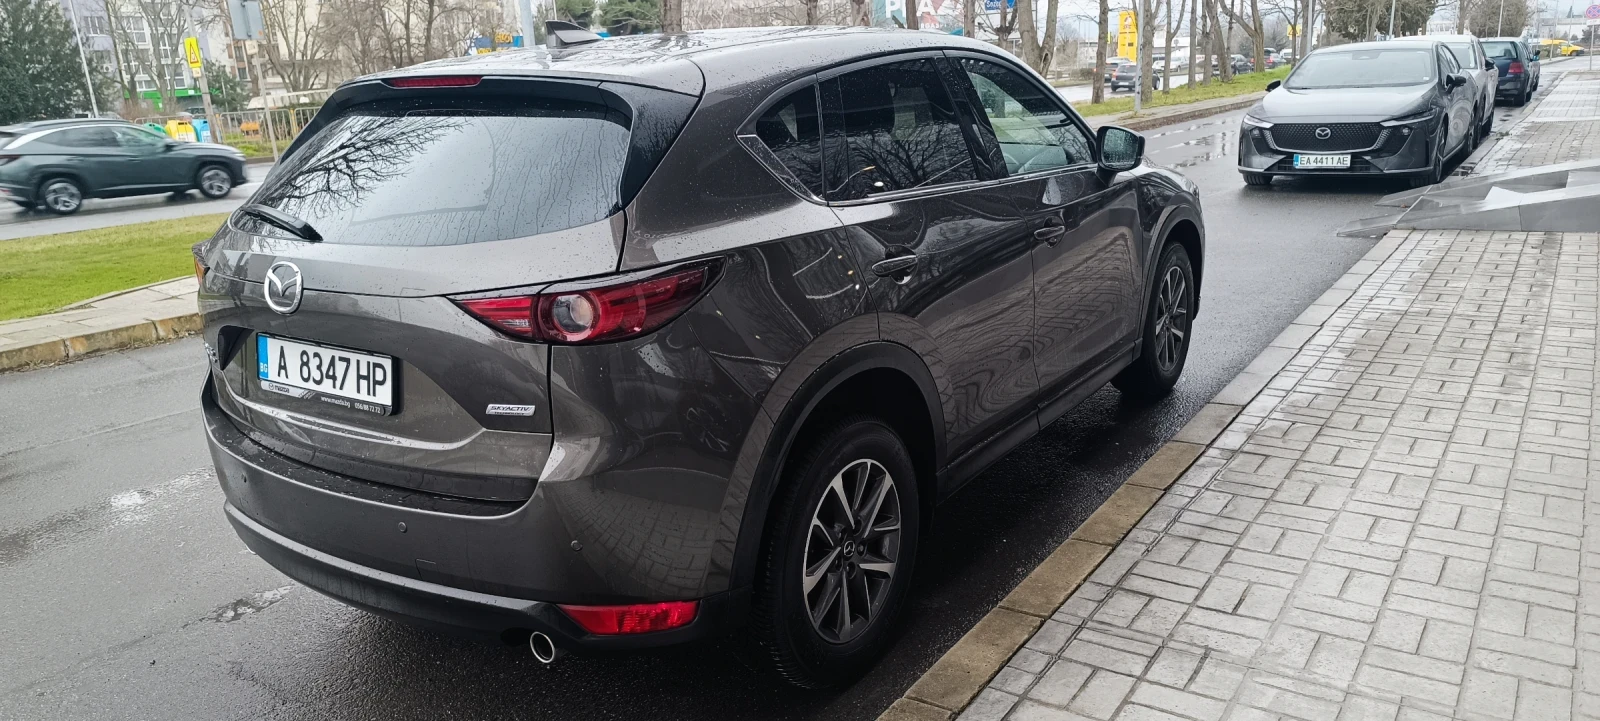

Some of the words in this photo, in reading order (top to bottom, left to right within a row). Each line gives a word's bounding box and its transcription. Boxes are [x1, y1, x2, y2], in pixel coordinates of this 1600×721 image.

[1300, 156, 1311, 165] EA
[1313, 156, 1334, 165] 4411
[1336, 156, 1348, 165] AE
[259, 362, 268, 372] BG
[277, 345, 288, 379] A
[299, 349, 350, 390] 8347
[355, 358, 386, 397] HP
[320, 396, 351, 408] www.mazda.bg
